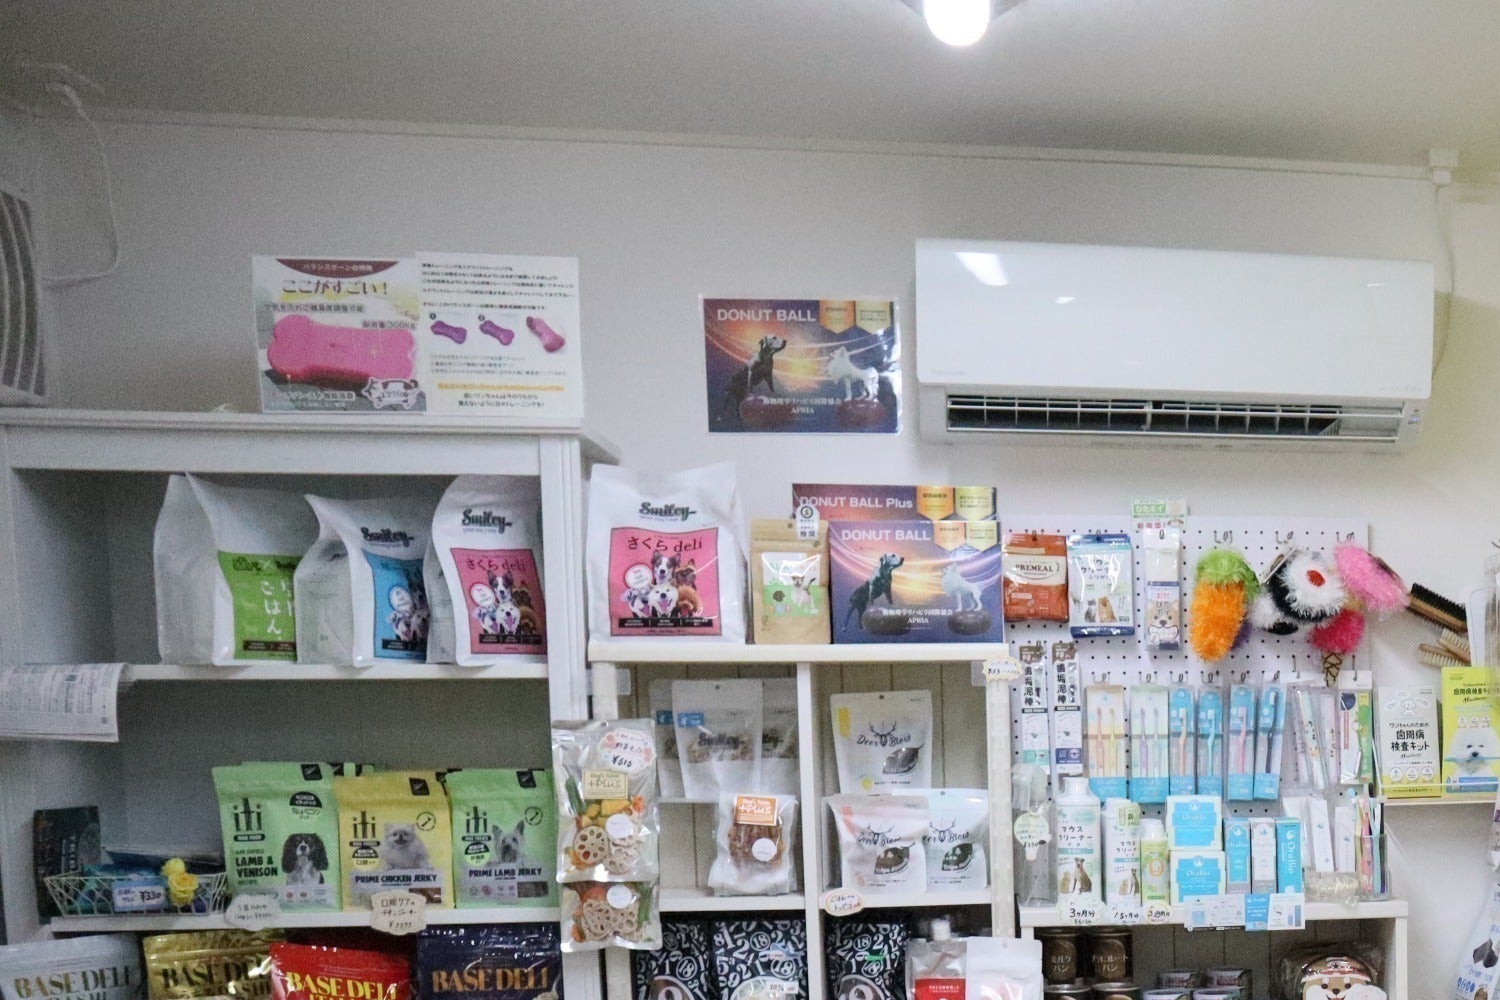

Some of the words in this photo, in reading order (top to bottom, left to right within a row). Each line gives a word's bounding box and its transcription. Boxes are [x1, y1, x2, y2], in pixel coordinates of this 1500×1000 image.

[716, 309, 772, 322] DONUT
[776, 309, 817, 322] BALL
[850, 496, 882, 508] BALL
[886, 498, 913, 509] Plus
[841, 529, 891, 541] DONUT
[895, 529, 931, 541] BALL
[235, 856, 264, 866] LAMB
[236, 866, 278, 878] VENISON
[468, 868, 493, 877] PRIME
[494, 867, 516, 877] LAMB
[517, 867, 542, 877] JERKY
[355, 874, 379, 884] PRIME
[381, 874, 412, 884] CHICKEN
[413, 873, 438, 883] JERKY
[13, 969, 81, 999] BASE
[82, 964, 132, 992] DELI
[285, 971, 347, 998] BASE
[431, 968, 492, 993] BASE
[496, 967, 550, 991] DELI
